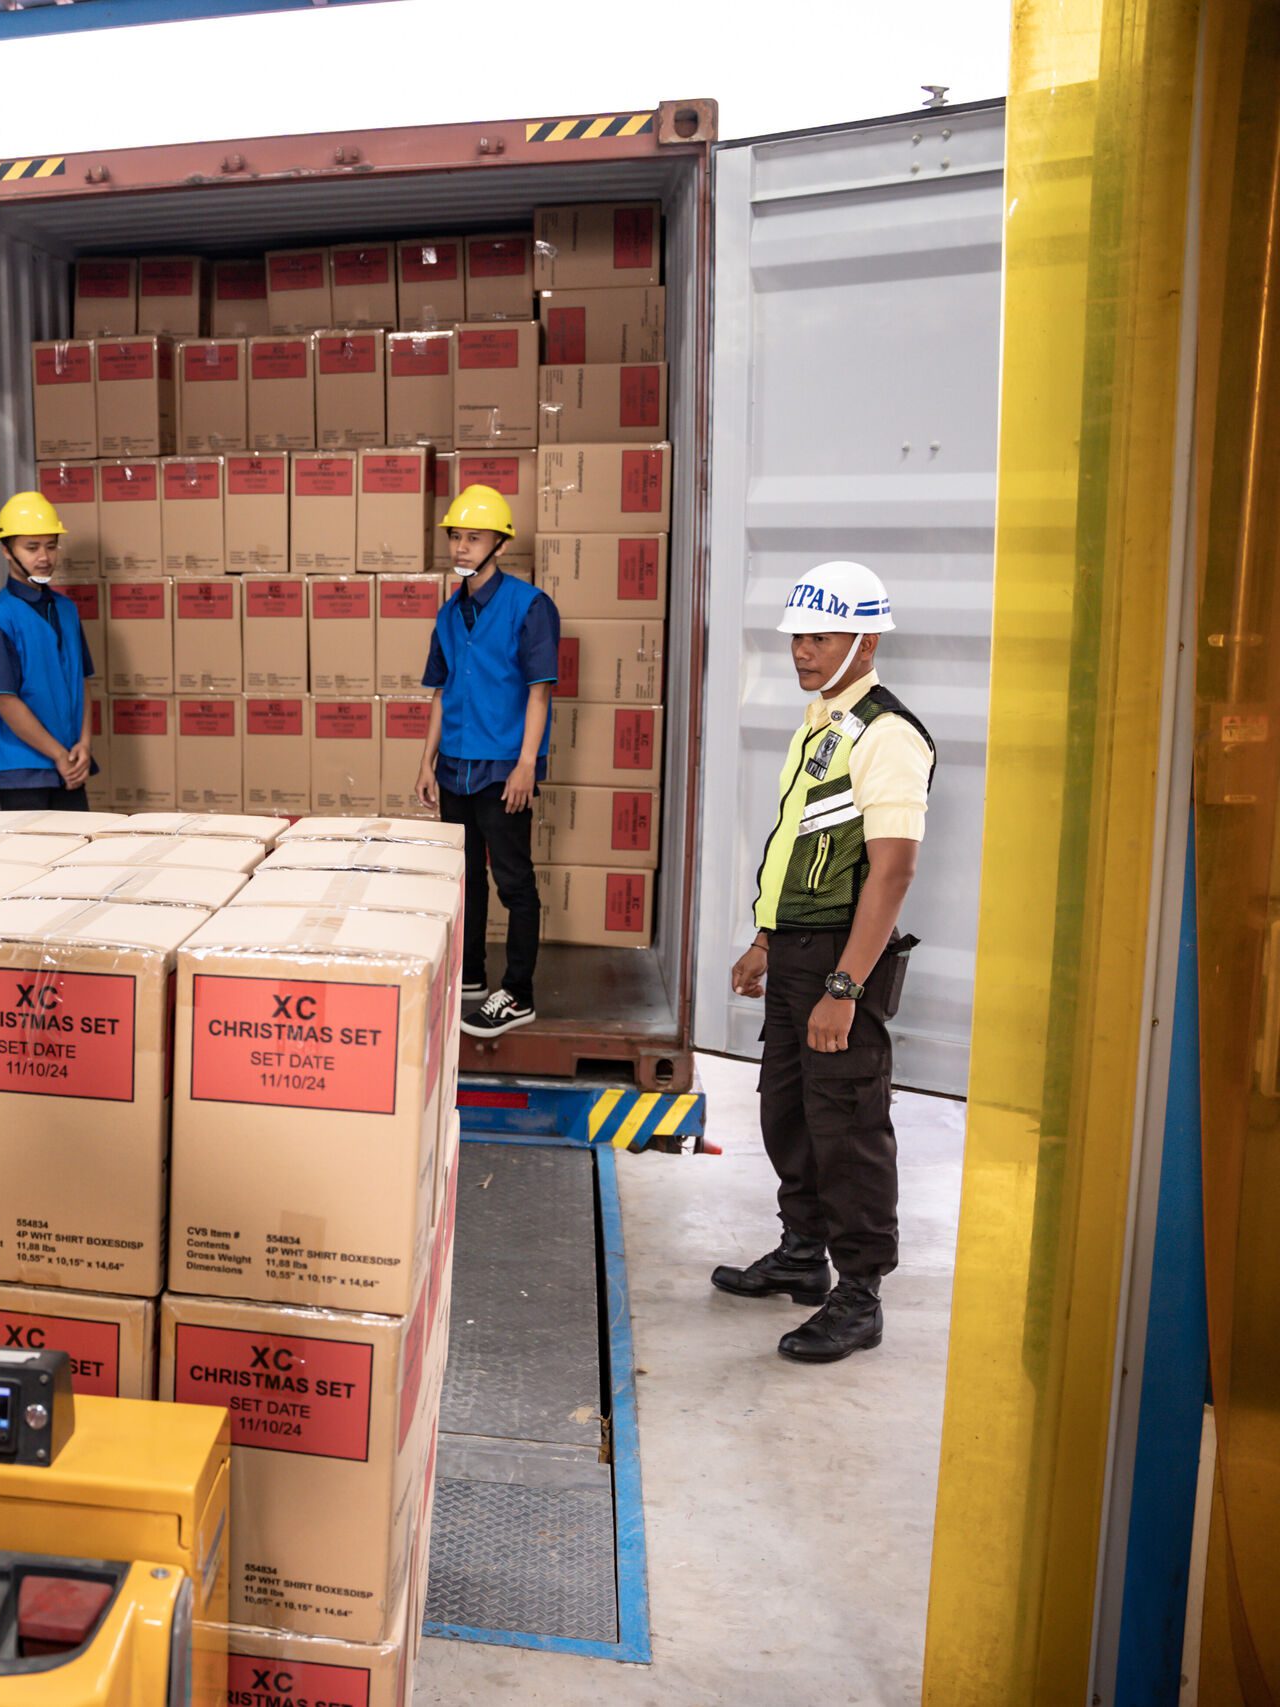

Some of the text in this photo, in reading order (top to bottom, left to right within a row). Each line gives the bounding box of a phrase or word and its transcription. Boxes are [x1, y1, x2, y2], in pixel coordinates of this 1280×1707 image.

[16, 984, 58, 1010] XC
[272, 995, 316, 1020] XC
[80, 1017, 119, 1035] SET
[208, 1020, 381, 1046] CHRISTMAS SET
[33, 1042, 76, 1059] DATE
[6, 1061, 68, 1078] 11/10/24
[250, 1051, 334, 1071] SET DATE
[260, 1073, 325, 1090] 11/10/24
[16, 1218, 48, 1229] 554834
[187, 1226, 208, 1237] CVS
[210, 1229, 231, 1238] Item
[16, 1230, 144, 1250] 4P WHT SHIRT BOXESDISP
[42, 1244, 56, 1253] lbs
[186, 1238, 230, 1250] Contents
[266, 1234, 301, 1245] 554834
[186, 1250, 251, 1265] Gross Weight
[265, 1246, 400, 1266] 4P WHT SHIRT BOXESDISP
[292, 1260, 308, 1270] lbs
[186, 1261, 243, 1274] Dimensions
[6, 1325, 48, 1349] XC
[70, 1358, 104, 1378] SET
[250, 1346, 293, 1372] XC
[189, 1365, 356, 1399] CHRISTMAS SET
[230, 1396, 310, 1419] SET DATE
[239, 1417, 302, 1436] 11/10/24
[245, 1563, 277, 1575] 554834
[244, 1574, 373, 1598] 4P WHT SHIRT BOXESDISP
[270, 1588, 284, 1600] lbs
[251, 1669, 293, 1693] XC
